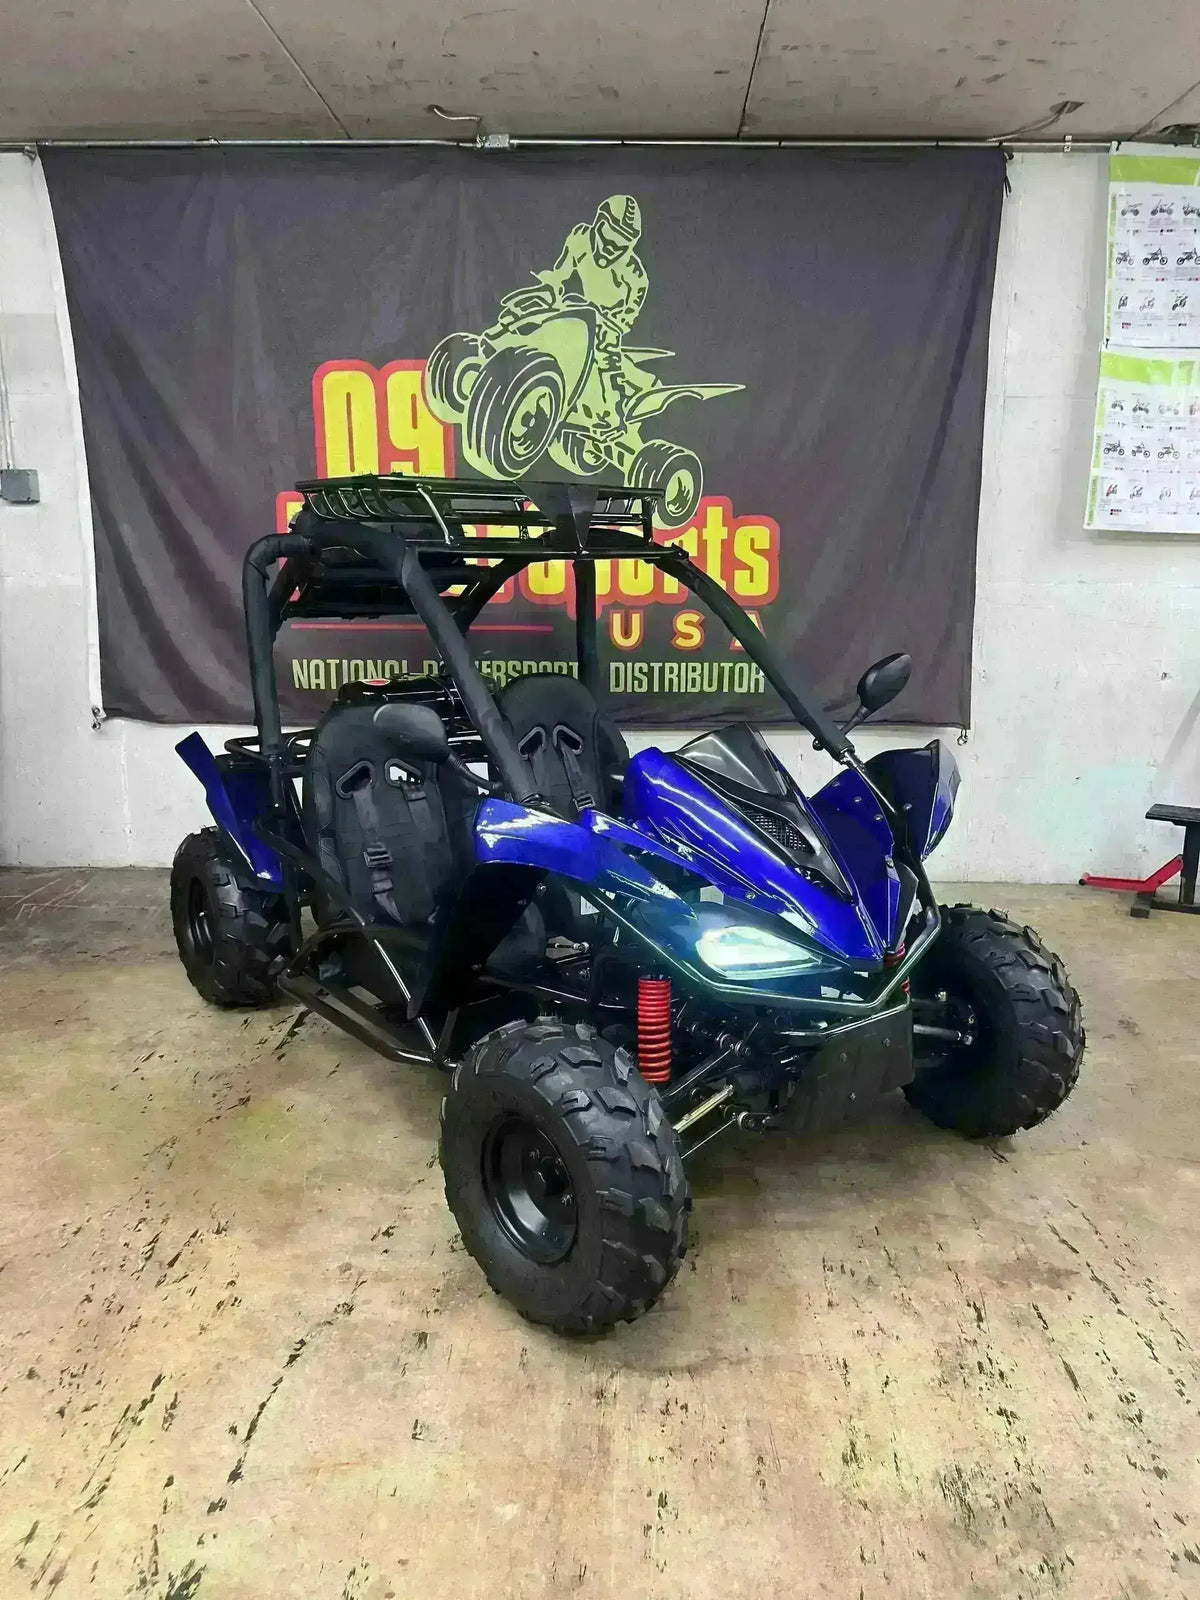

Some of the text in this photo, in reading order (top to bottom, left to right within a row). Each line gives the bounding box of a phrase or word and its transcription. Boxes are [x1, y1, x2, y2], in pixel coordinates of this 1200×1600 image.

[315, 362, 452, 479] 09
[609, 611, 767, 651] US
[609, 662, 765, 693] DISTRIBUTOR
